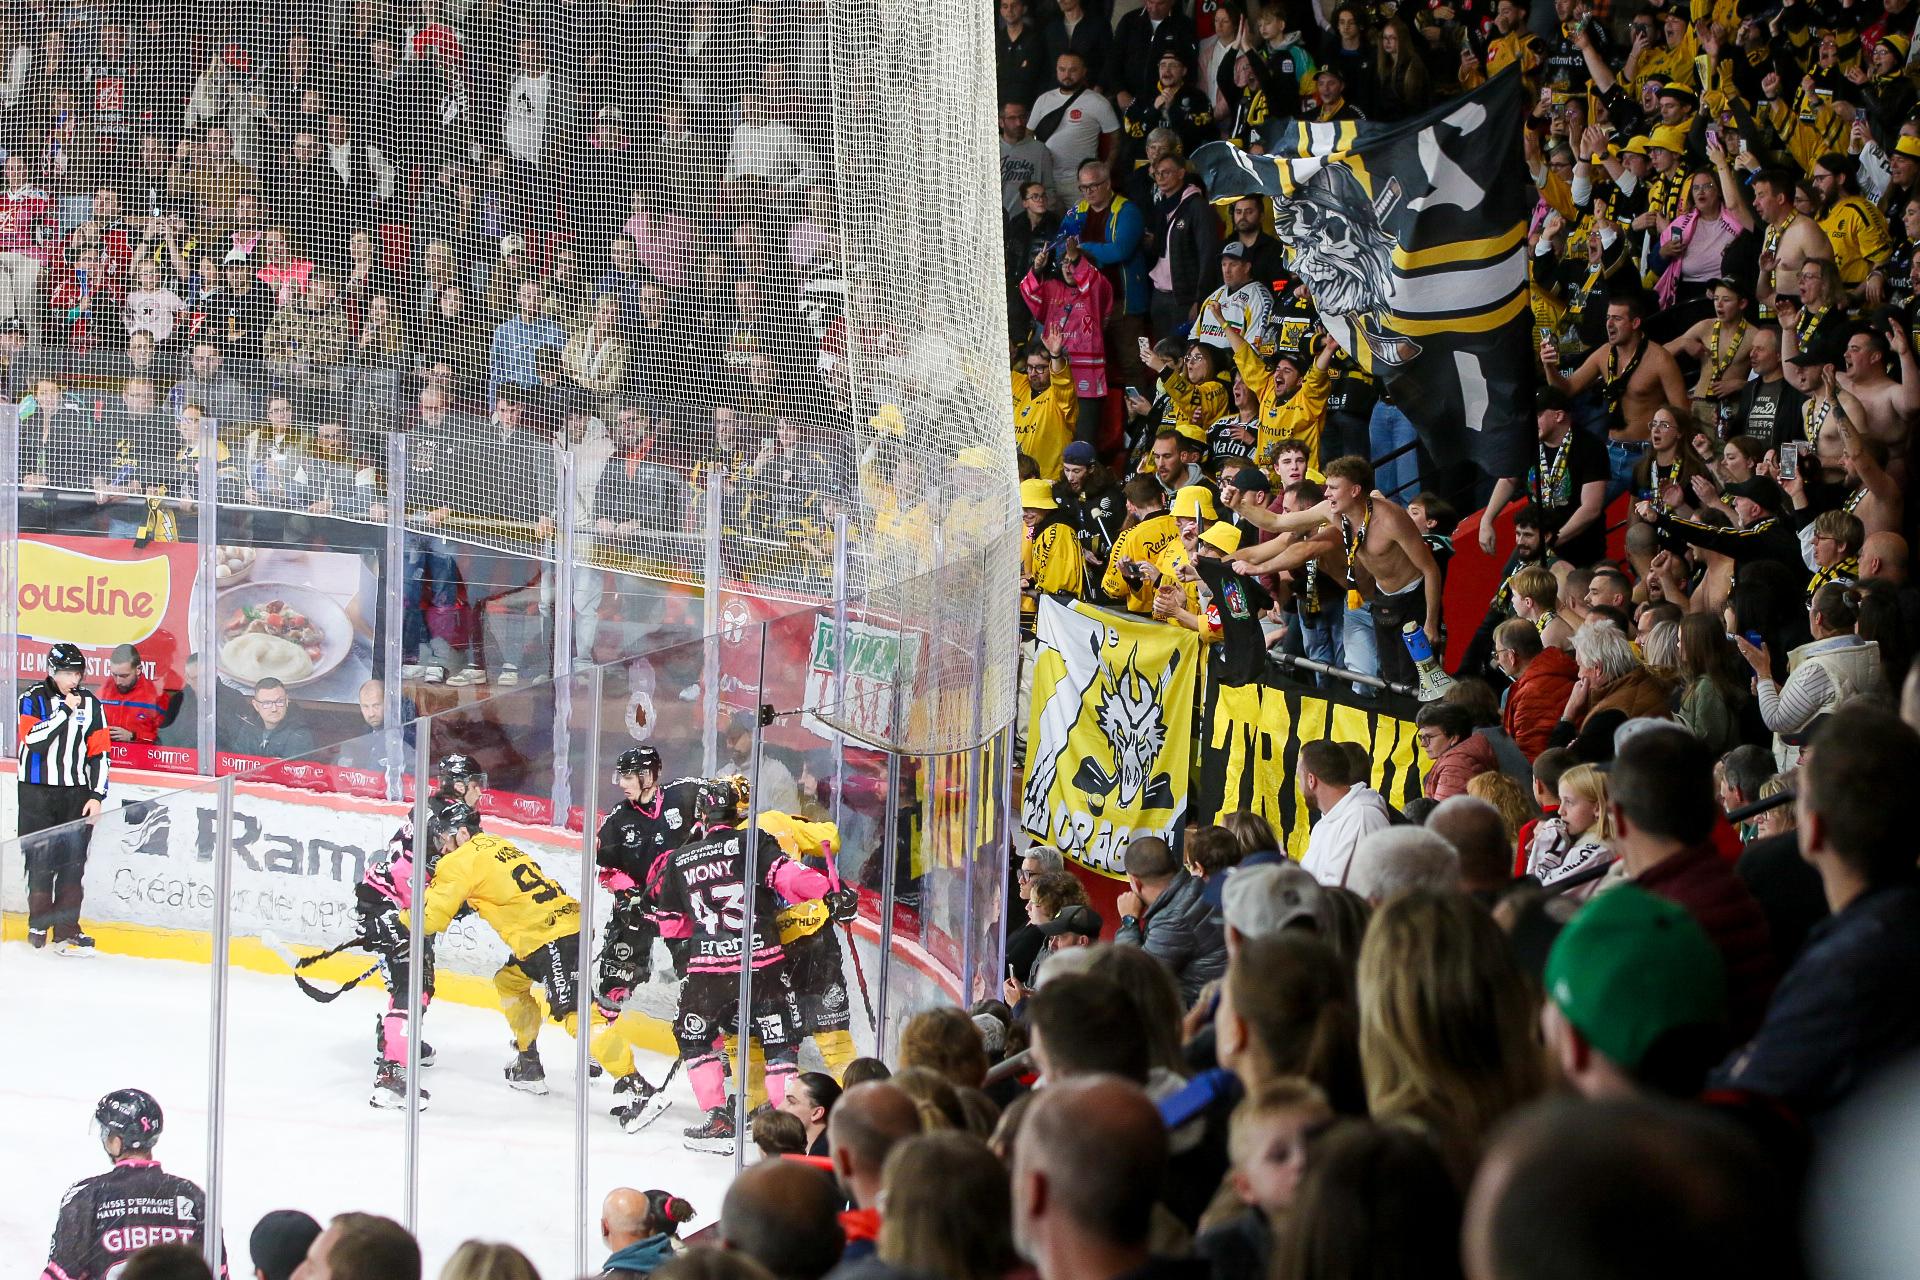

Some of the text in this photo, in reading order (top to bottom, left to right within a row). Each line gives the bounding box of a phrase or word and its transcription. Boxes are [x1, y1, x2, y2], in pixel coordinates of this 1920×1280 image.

[17, 575, 154, 619] ousline
[147, 748, 190, 764] somme
[222, 756, 261, 771] somme
[97, 1206, 174, 1219] HAUTS DE FRANCE
